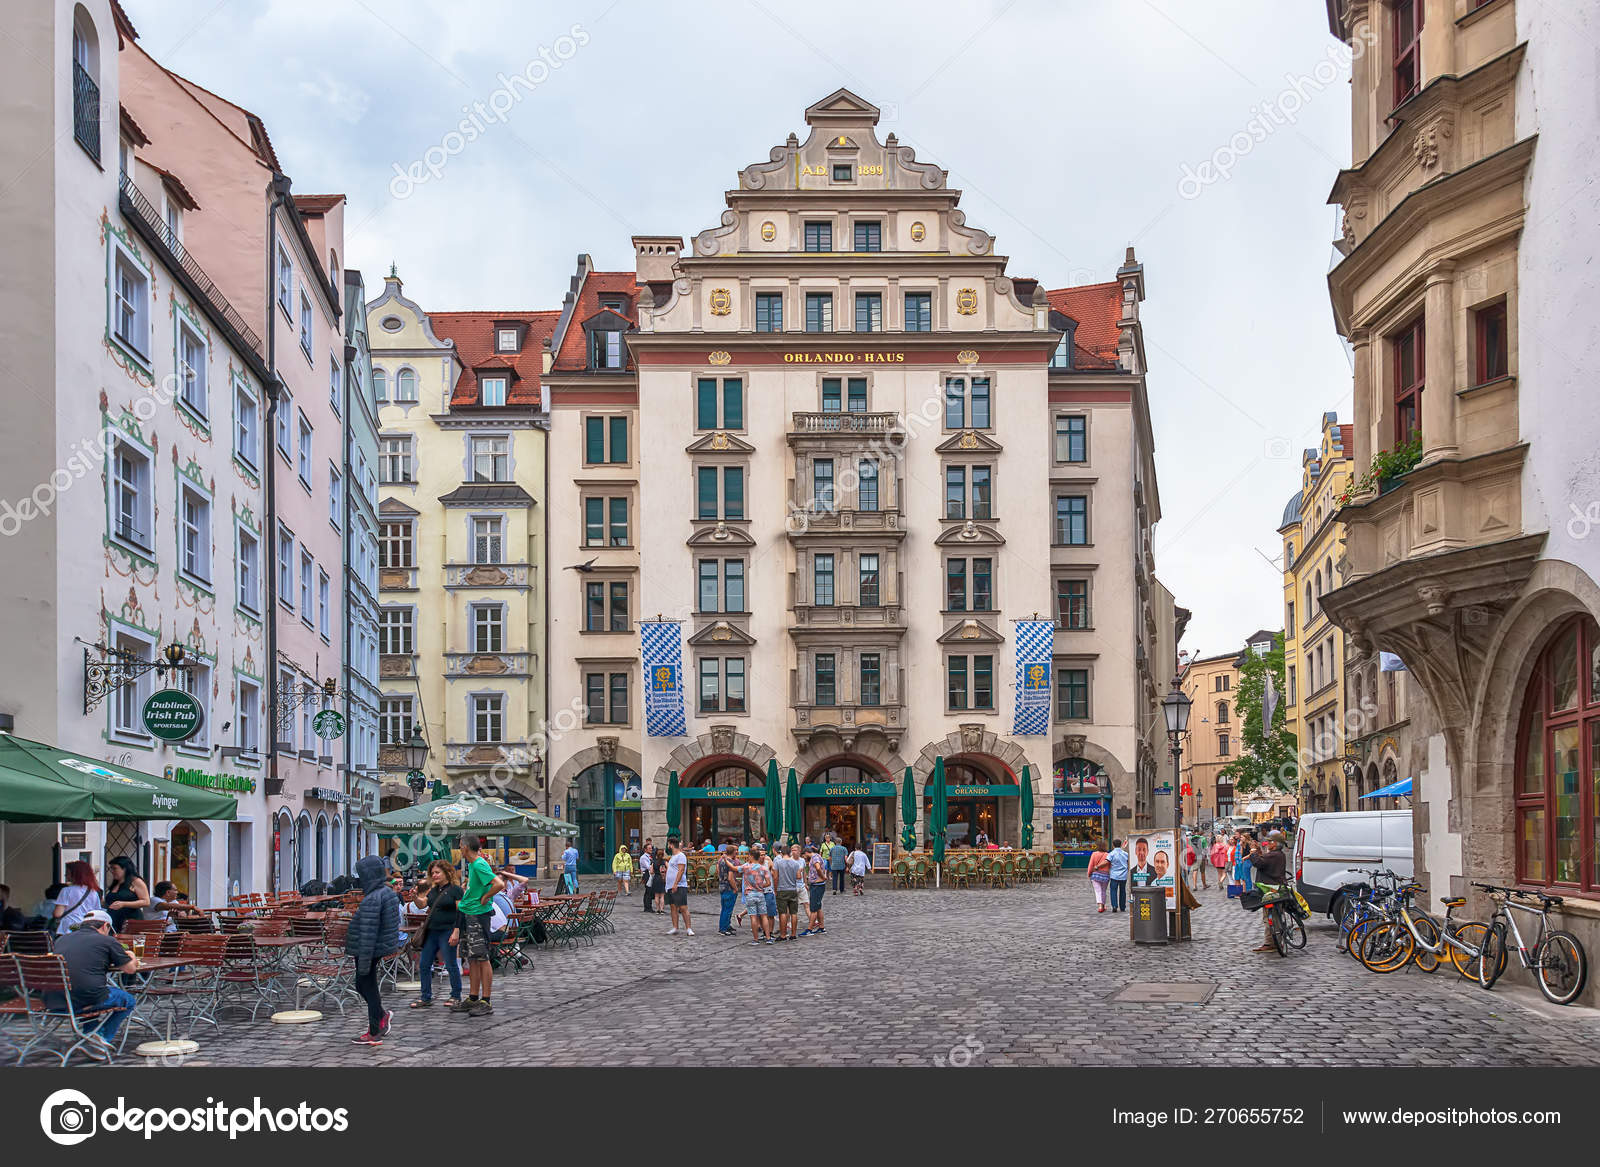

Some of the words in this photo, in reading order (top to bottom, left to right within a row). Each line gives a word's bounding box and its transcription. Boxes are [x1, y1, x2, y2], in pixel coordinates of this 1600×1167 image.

[802, 165, 828, 176] A.D.
[858, 165, 883, 176] 1899
[784, 353, 854, 363] ORLANDO
[864, 353, 905, 363] HAUS
[151, 701, 193, 709] Dubliner
[146, 711, 172, 720] Irish
[174, 711, 196, 720] Pub
[825, 787, 870, 796] ORLANDO
[954, 787, 989, 795] ORLANDO
[152, 793, 179, 810] Ayinger
